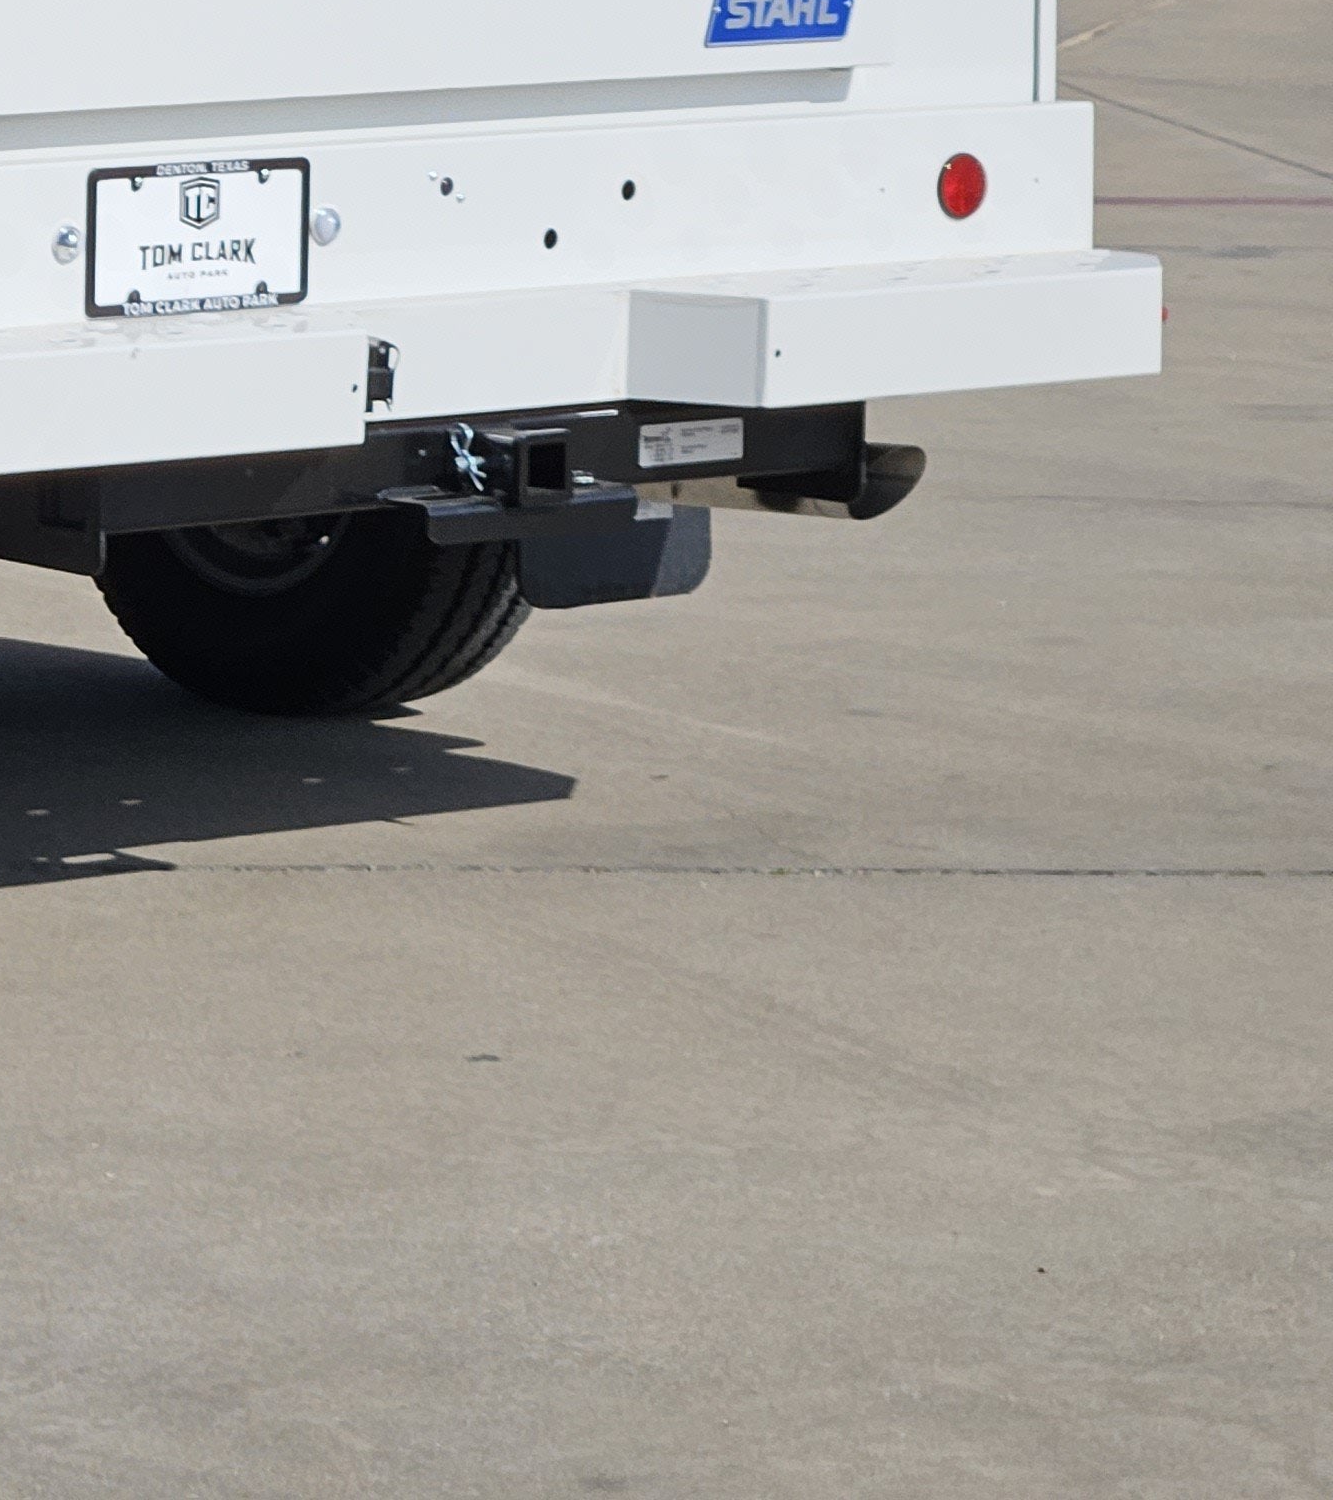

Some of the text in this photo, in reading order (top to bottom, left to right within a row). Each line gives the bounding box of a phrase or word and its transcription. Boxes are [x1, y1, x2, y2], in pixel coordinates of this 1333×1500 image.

[211, 160, 250, 173] TEXAS
[139, 238, 257, 270] TOM CLARK
[122, 293, 279, 317] TOM CLARK AUTO PARK
